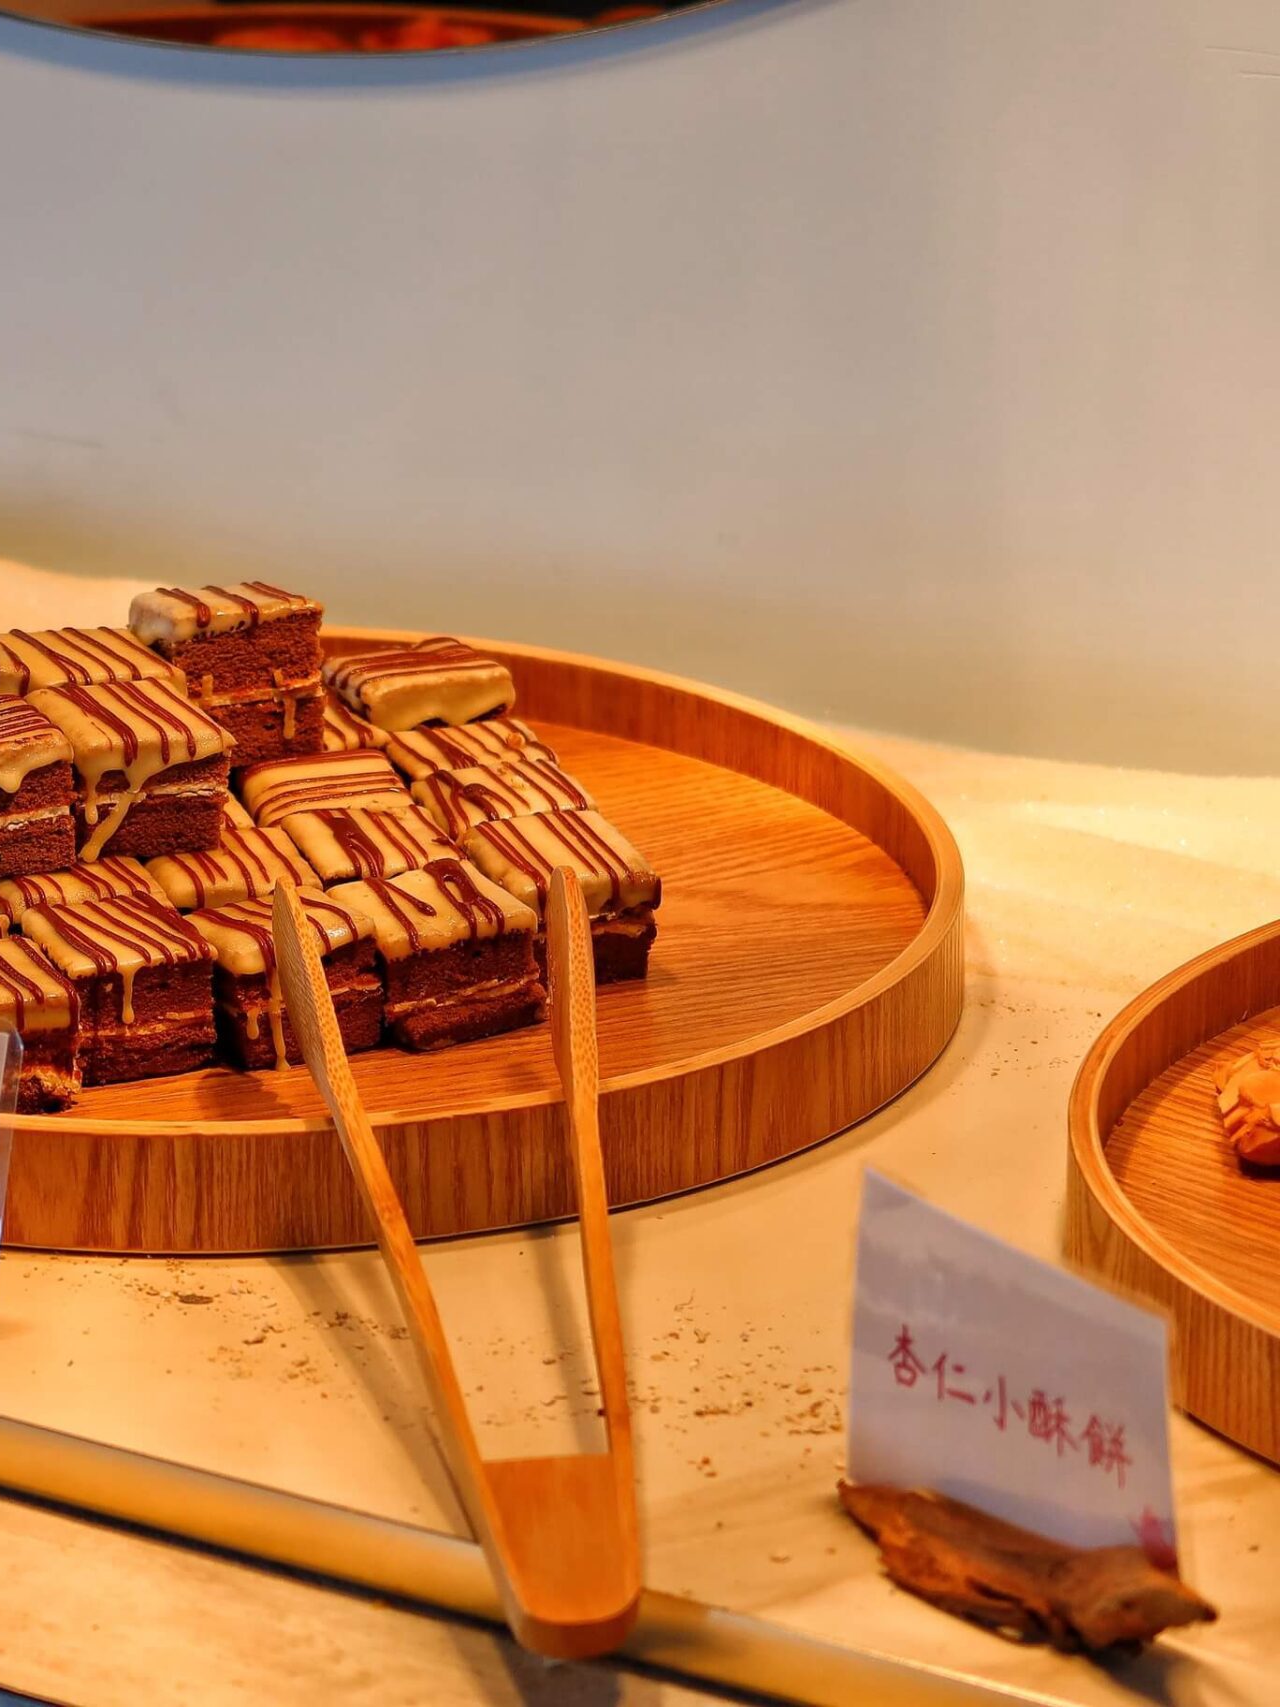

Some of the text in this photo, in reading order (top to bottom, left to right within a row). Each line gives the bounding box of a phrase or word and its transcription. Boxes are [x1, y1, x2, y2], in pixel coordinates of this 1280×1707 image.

[888, 1323, 1133, 1489] 杏仁小酥餅
